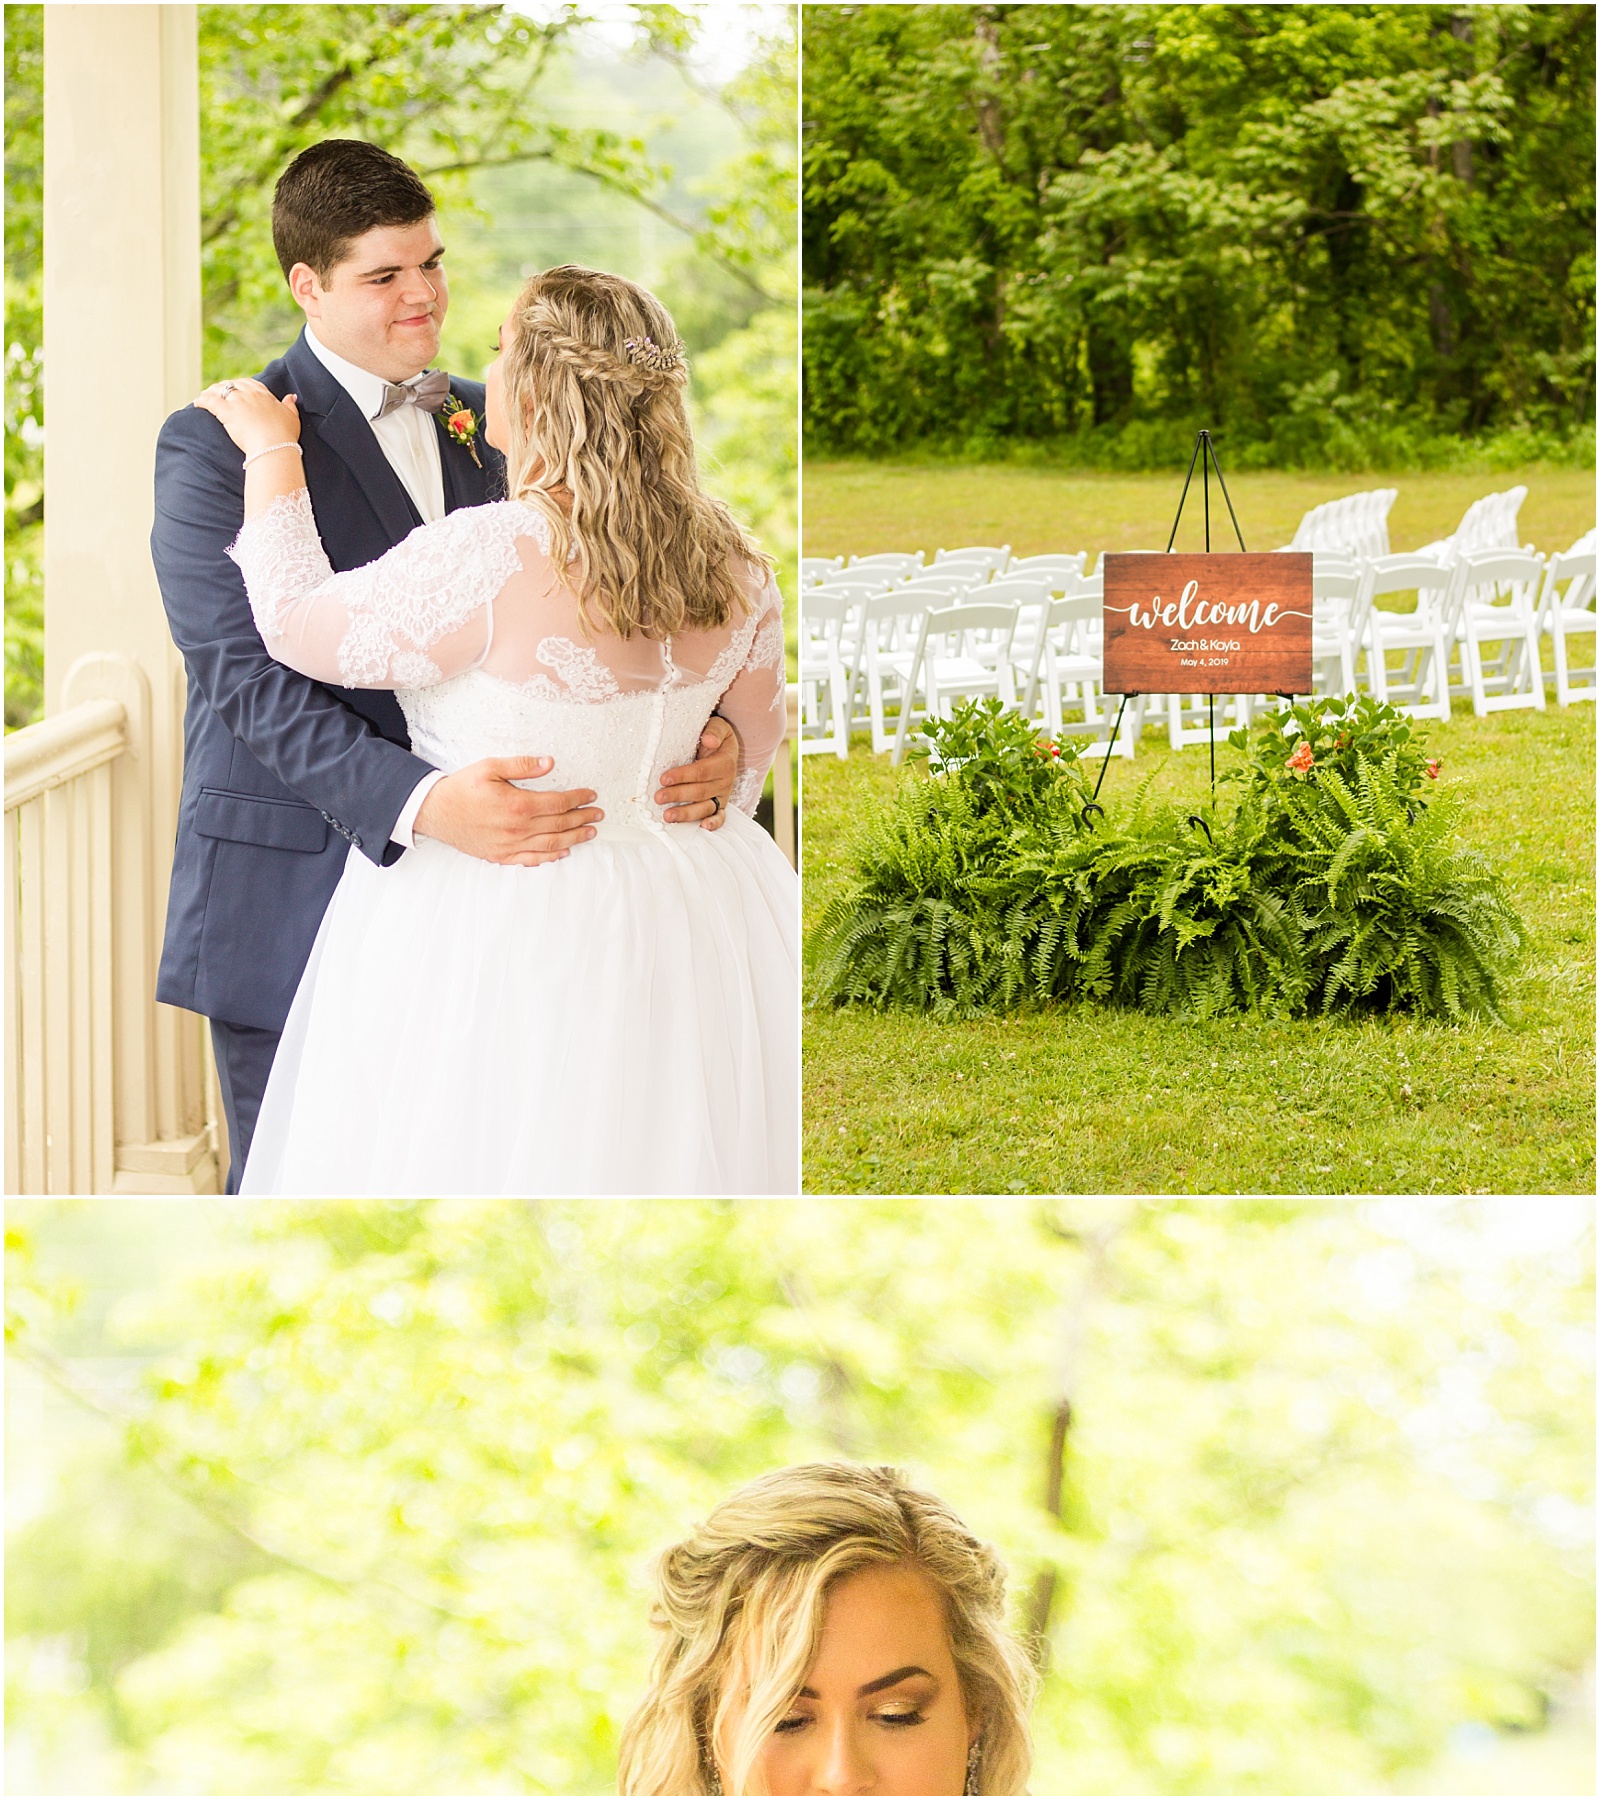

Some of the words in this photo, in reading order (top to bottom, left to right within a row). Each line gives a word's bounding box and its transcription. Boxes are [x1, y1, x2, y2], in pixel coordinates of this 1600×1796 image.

[1103, 580, 1313, 633] welcome
[1170, 638, 1199, 651] Zach
[1209, 638, 1241, 653] Kayla
[1180, 658, 1197, 668] May
[1199, 658, 1207, 667] 4,
[1208, 658, 1229, 666] 2019
